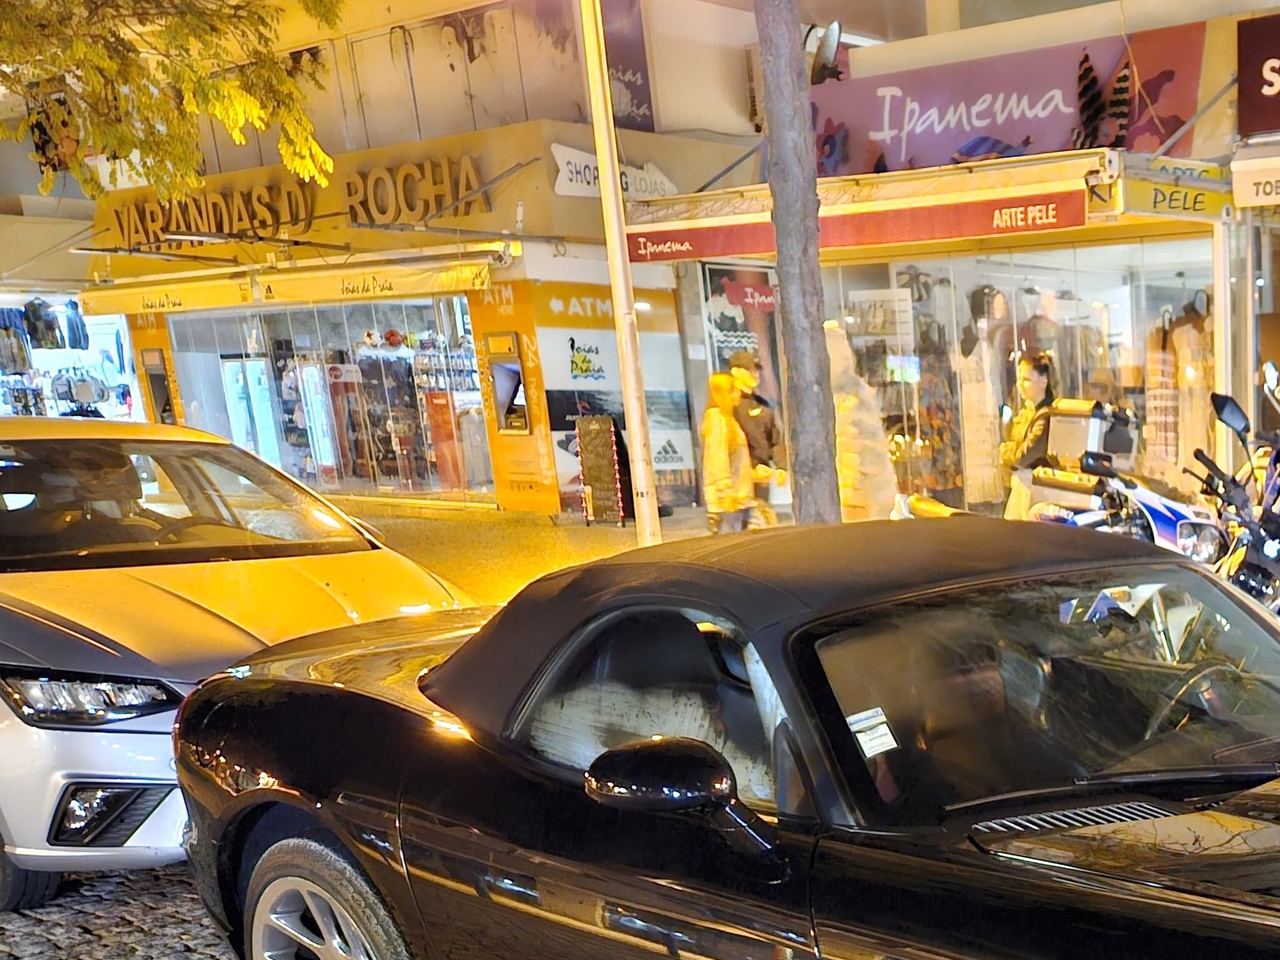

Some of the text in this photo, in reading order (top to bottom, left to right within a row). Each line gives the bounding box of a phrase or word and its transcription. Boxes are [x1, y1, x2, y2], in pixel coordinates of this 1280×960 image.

[609, 66, 643, 84] oias
[869, 86, 1075, 162] Ipanema
[566, 160, 629, 192] SHOPG
[113, 185, 278, 251] VARANDAS
[343, 155, 492, 226] ROCHA
[1153, 188, 1206, 211] PELE
[993, 203, 1058, 229] ARTE PELE
[638, 236, 692, 258] Ipanema
[568, 297, 613, 316] ATM
